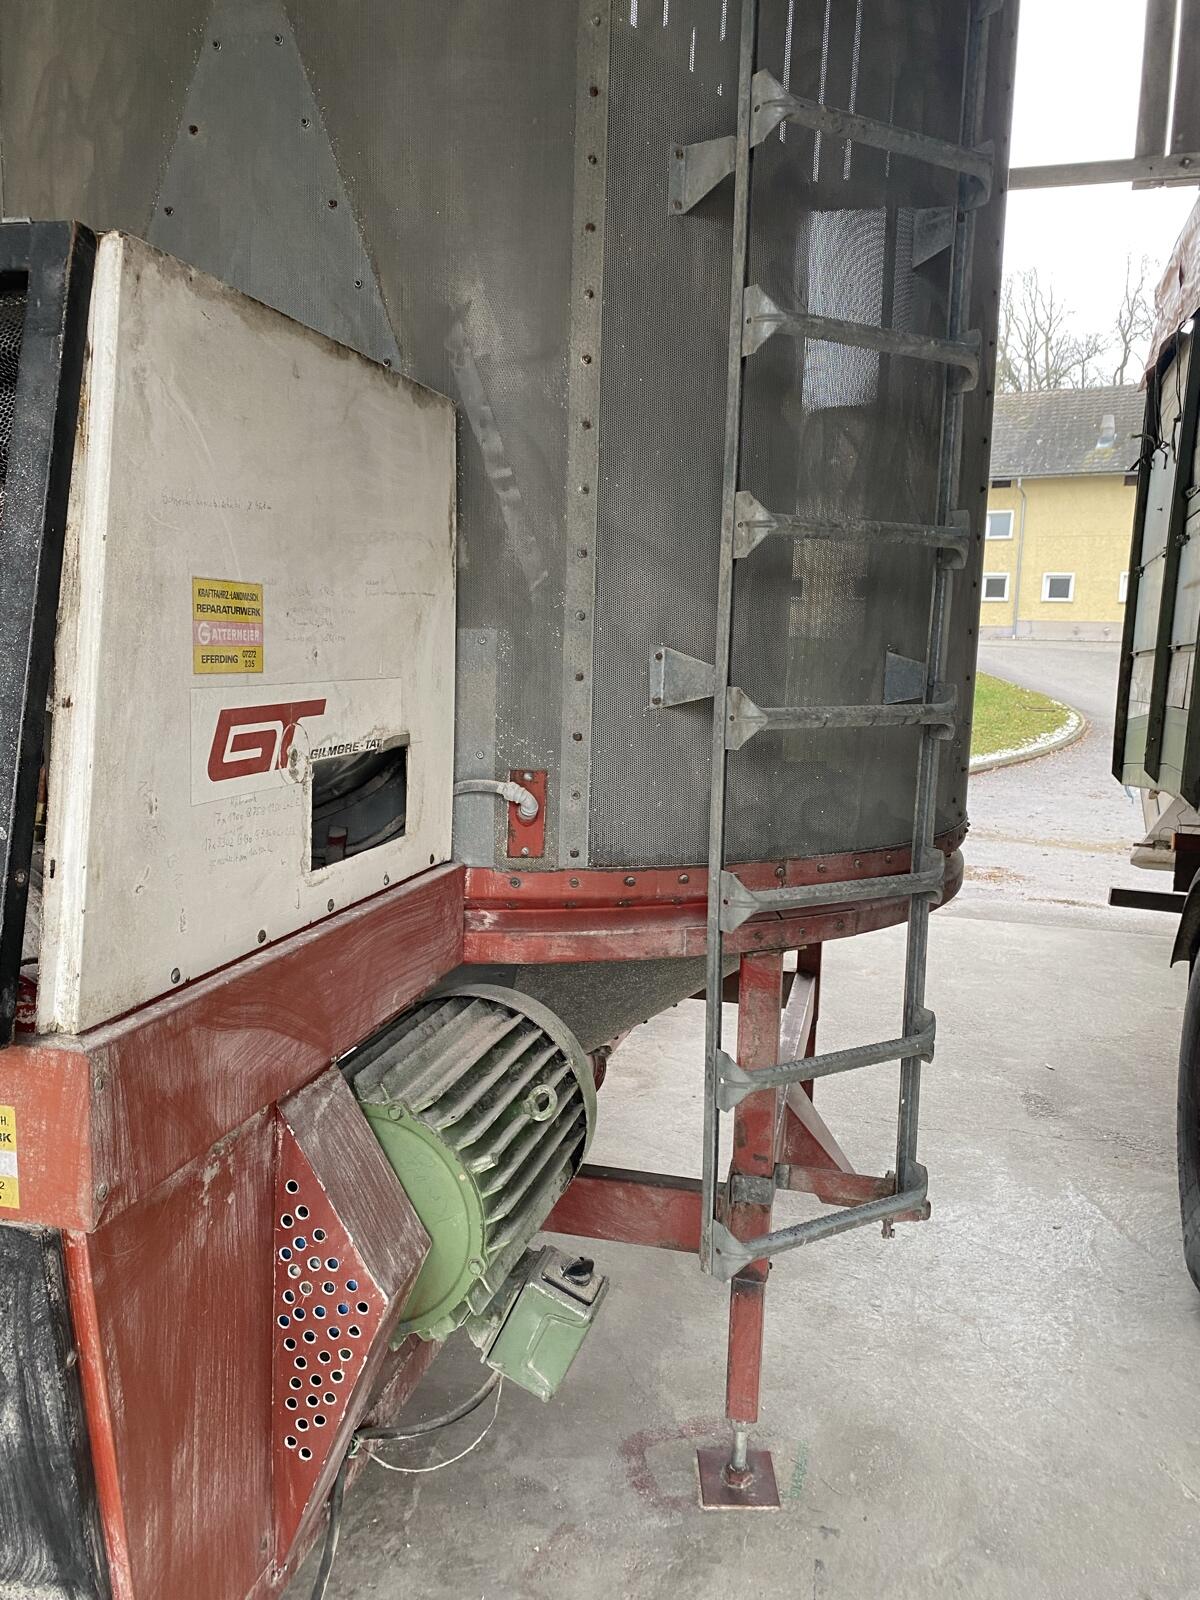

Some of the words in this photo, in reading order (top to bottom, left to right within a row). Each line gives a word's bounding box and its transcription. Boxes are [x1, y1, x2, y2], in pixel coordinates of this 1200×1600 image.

[196, 603, 261, 617] REPARATURWERK
[198, 621, 260, 645] GATTERMEIER
[201, 654, 239, 664] EFERDING
